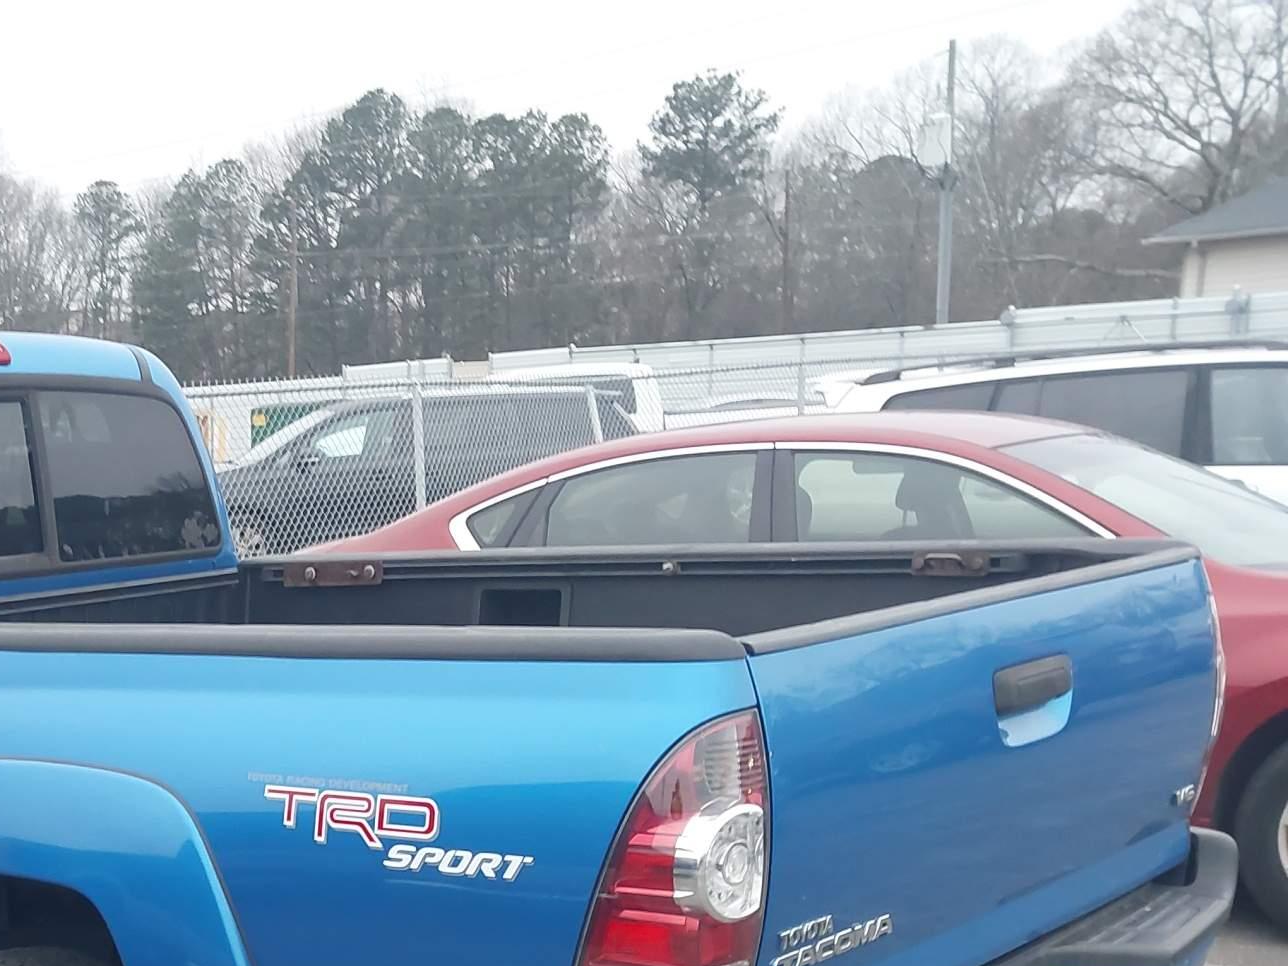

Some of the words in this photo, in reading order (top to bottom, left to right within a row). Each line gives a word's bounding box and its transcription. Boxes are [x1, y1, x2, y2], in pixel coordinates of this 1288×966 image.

[1175, 783, 1195, 806] V6
[264, 784, 440, 849] TRD
[382, 844, 535, 882] SPORT
[777, 914, 834, 950] TOYOTA
